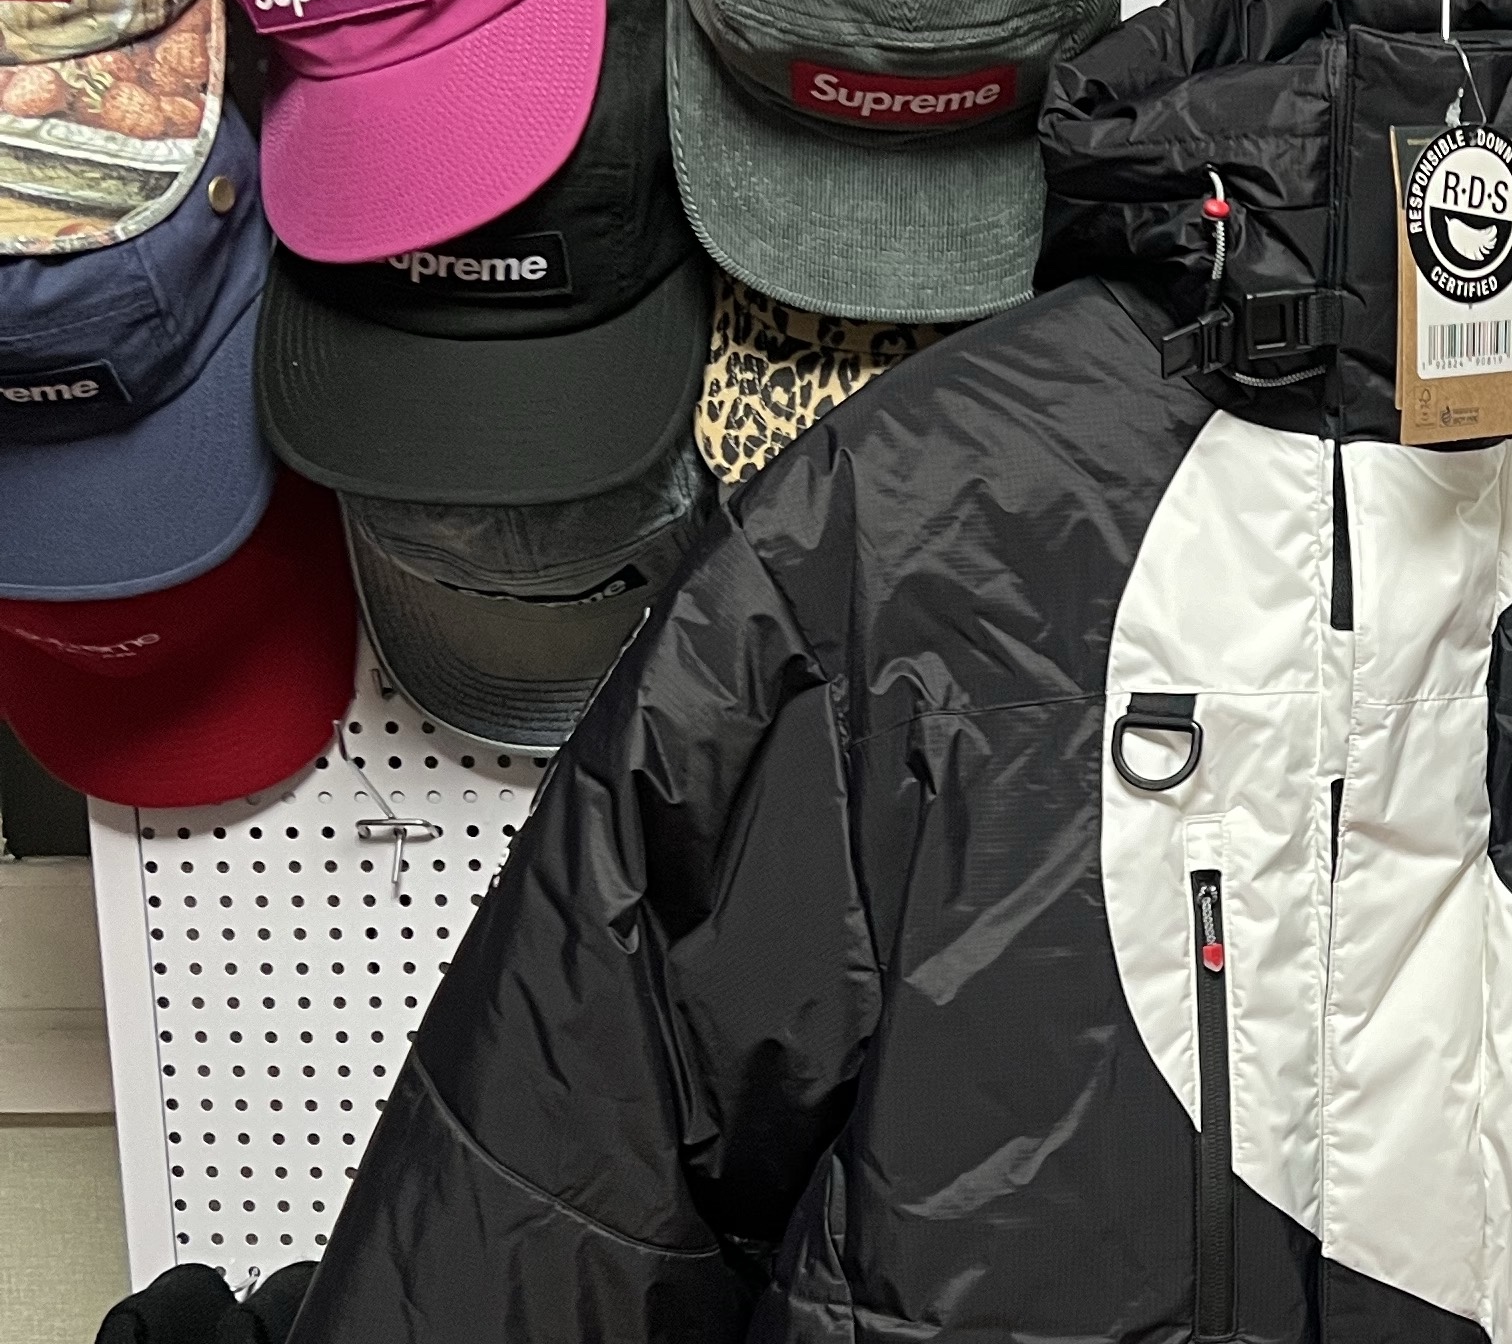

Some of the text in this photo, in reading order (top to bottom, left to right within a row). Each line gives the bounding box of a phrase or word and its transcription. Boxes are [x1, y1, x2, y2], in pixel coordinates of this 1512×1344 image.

[810, 73, 1001, 117] Supreme
[1408, 128, 1466, 234] RESPONSIBLE
[1430, 265, 1498, 298] CERTIFIED
